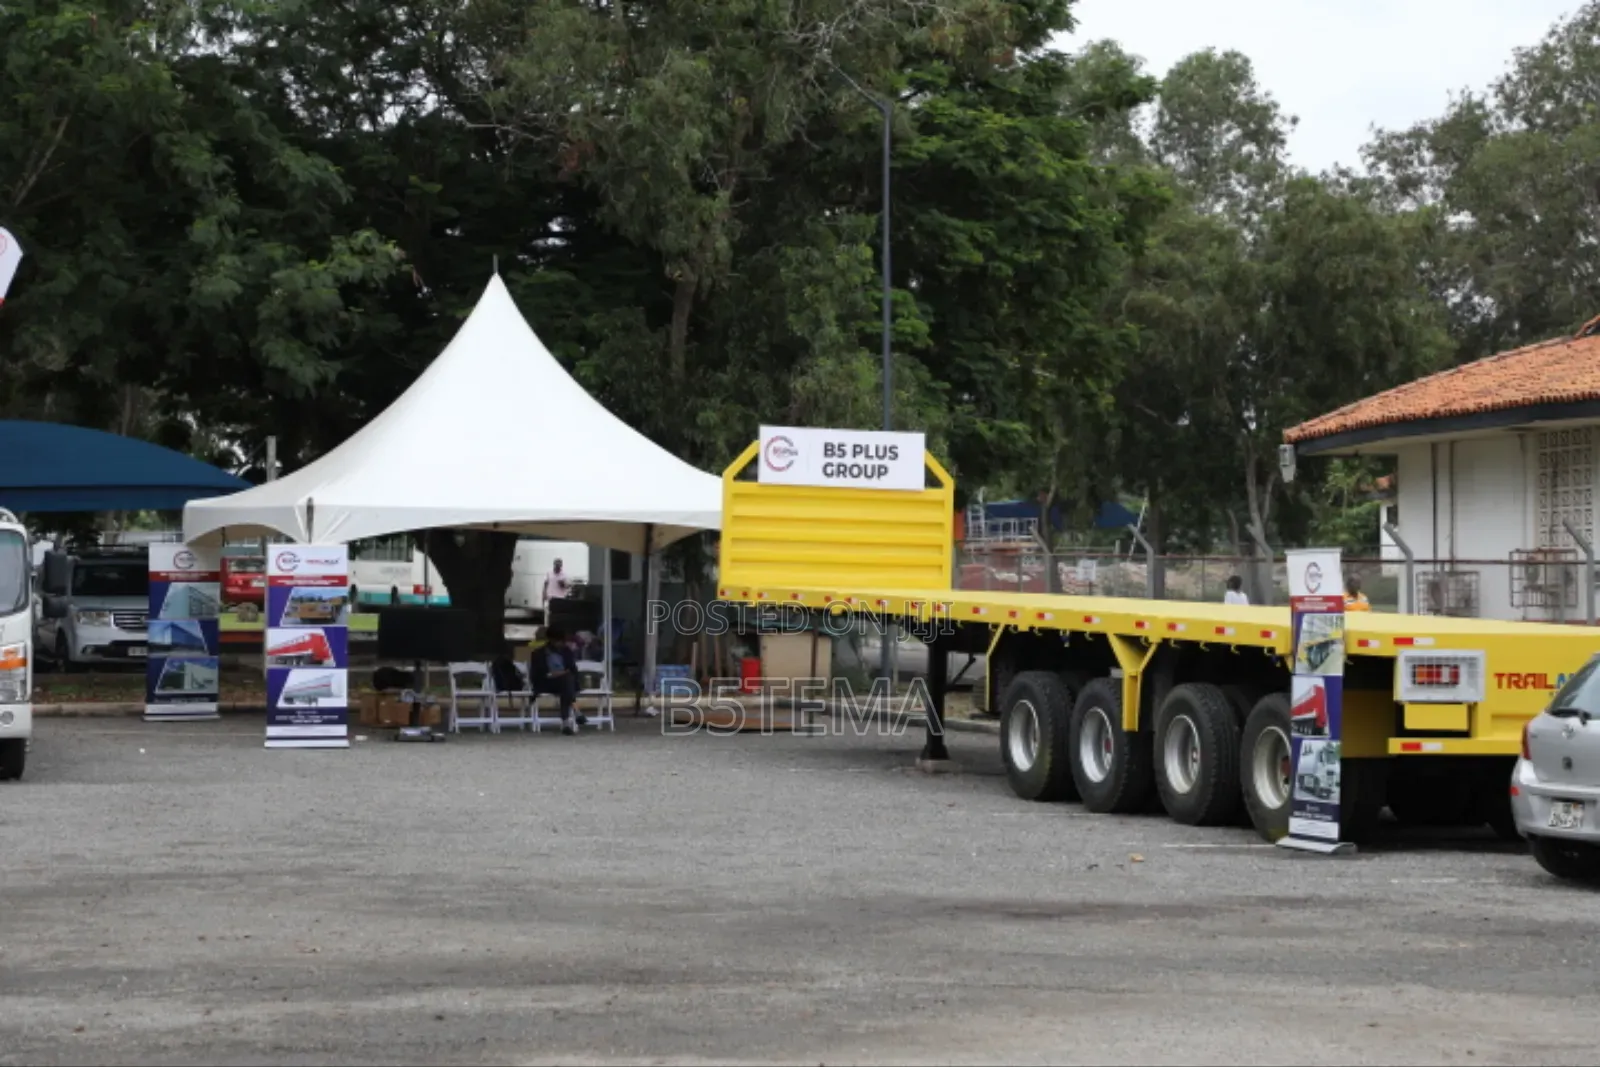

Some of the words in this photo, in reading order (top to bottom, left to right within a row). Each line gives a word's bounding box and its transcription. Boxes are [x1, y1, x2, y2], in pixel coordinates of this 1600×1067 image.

[823, 442, 847, 459] B5
[852, 444, 899, 461] PLUS
[822, 462, 889, 479] GROUP
